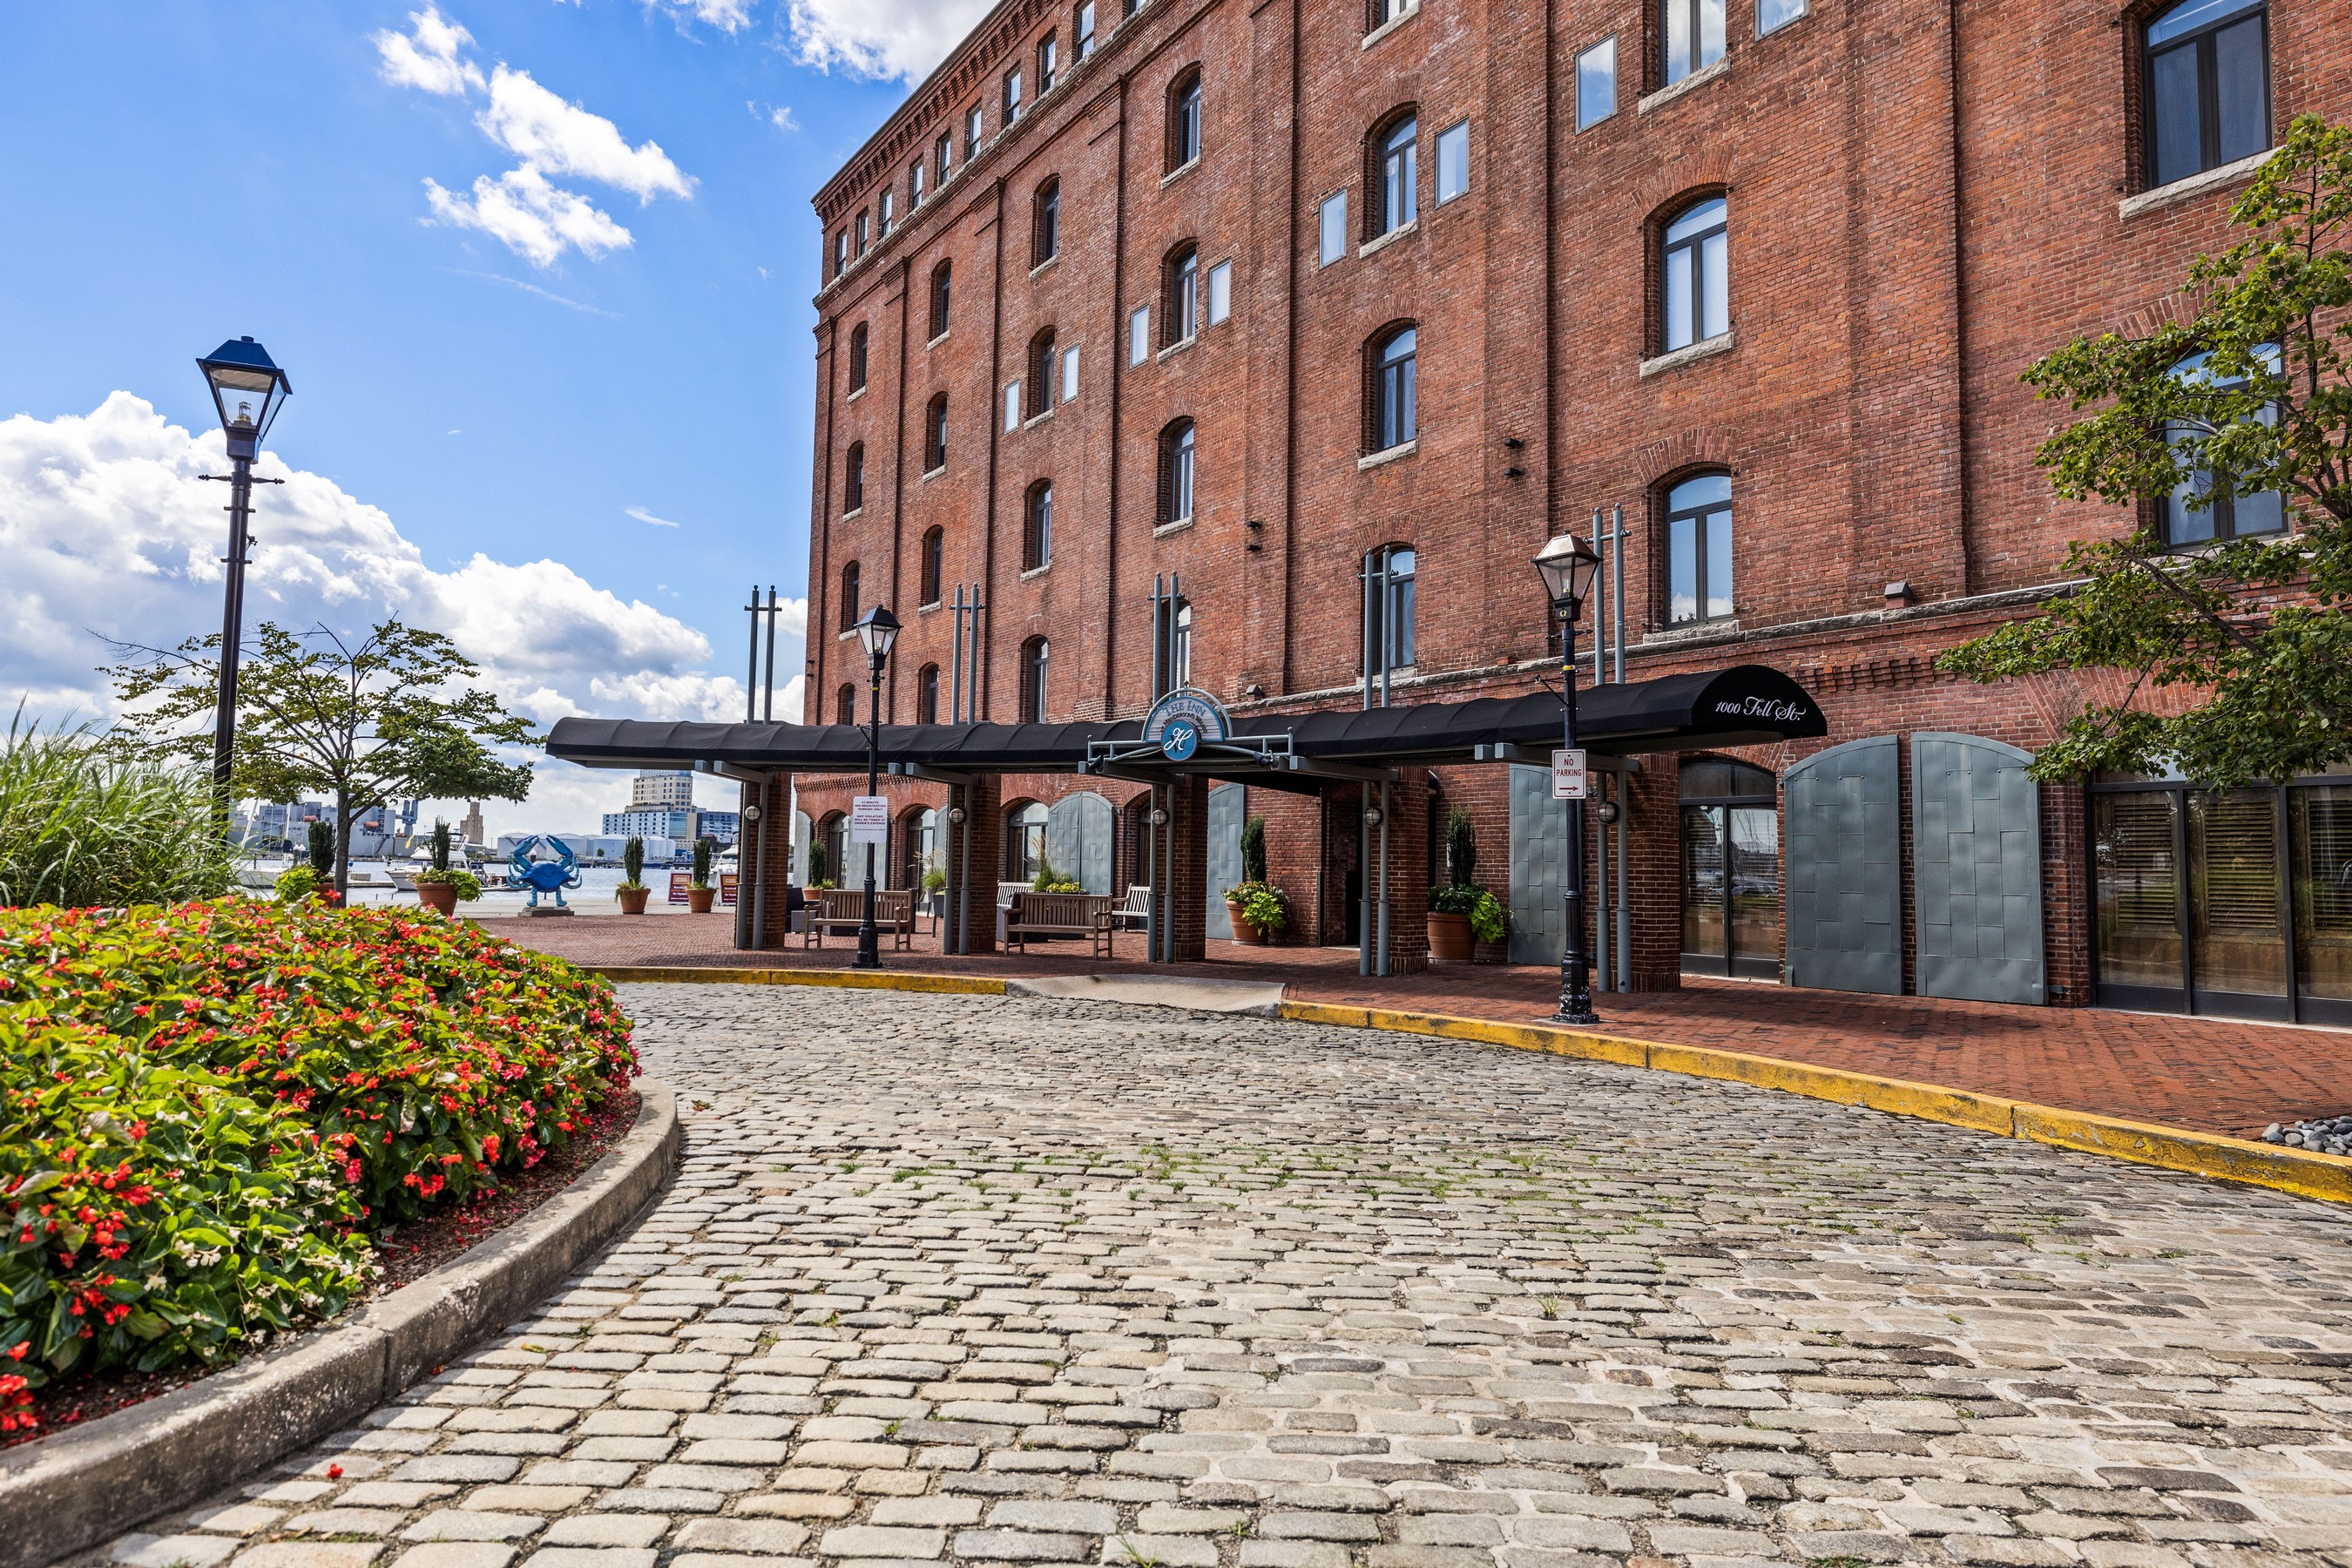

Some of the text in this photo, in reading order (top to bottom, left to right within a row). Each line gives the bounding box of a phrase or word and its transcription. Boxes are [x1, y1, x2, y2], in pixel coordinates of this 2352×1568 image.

[1162, 700, 1206, 717] THE INN
[1714, 696, 1807, 721] 1000 Fell St.
[1556, 758, 1582, 777] NO PARKING
